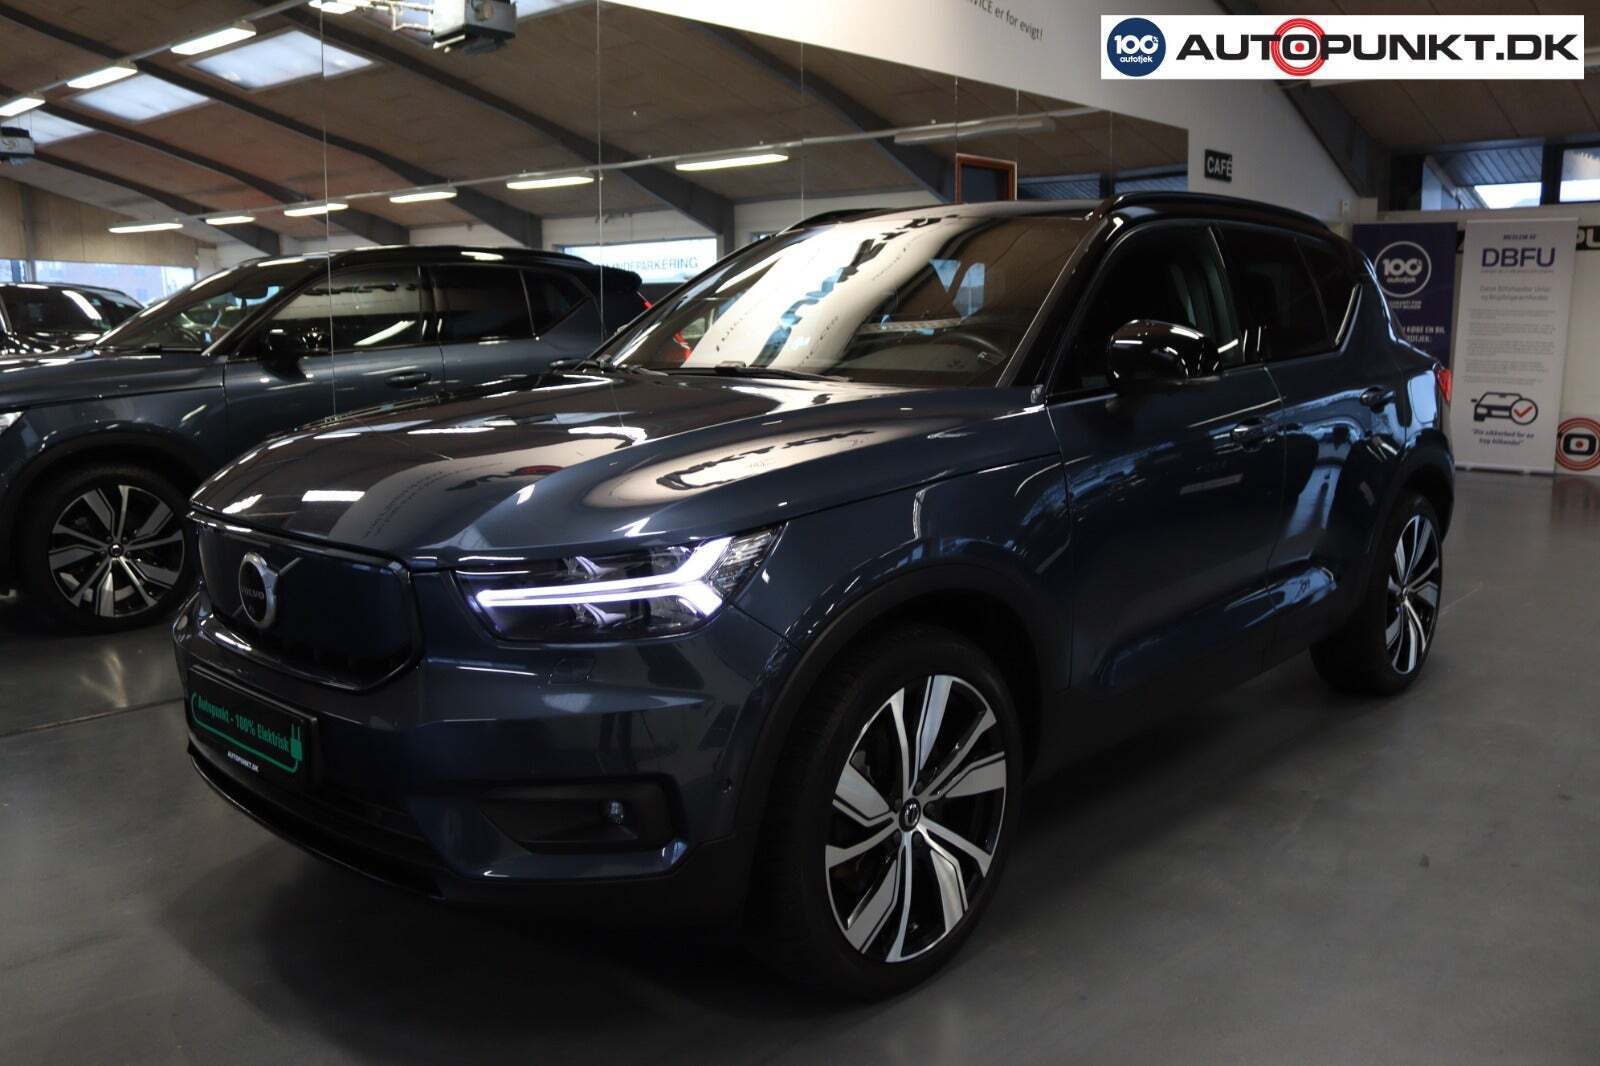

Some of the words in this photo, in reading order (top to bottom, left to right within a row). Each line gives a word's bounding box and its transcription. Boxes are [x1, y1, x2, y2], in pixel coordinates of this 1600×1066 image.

[994, 7, 1004, 19] er
[1006, 10, 1018, 27] for
[1020, 21, 1043, 41] evigt!
[1207, 156, 1232, 177] CAFÉ
[1481, 246, 1556, 268] DBFU
[197, 695, 229, 725] Autopunkt
[234, 713, 257, 737] 100%
[257, 723, 290, 752] Elektrisk
